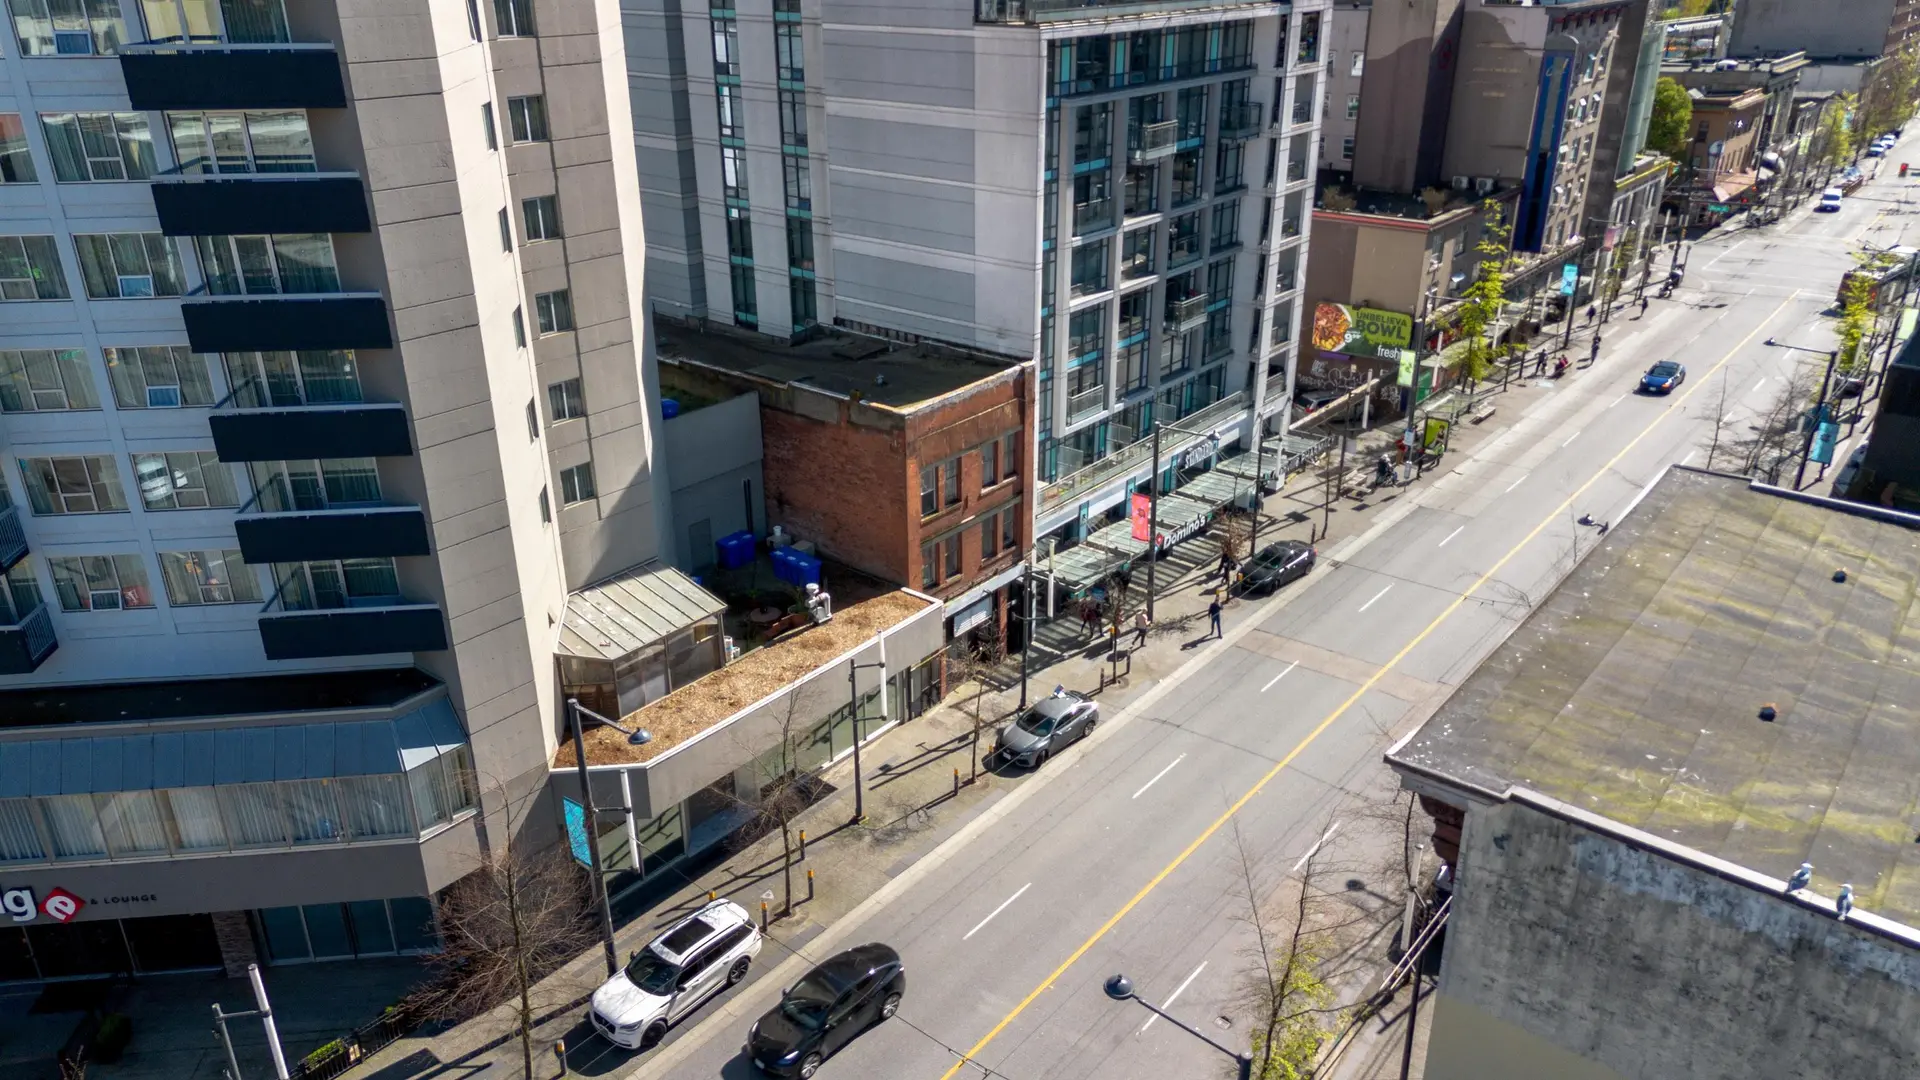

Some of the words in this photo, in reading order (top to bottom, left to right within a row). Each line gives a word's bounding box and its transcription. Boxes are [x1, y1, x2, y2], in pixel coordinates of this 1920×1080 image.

[1356, 312, 1407, 327] UNBELIEVA
[1356, 319, 1406, 341] BOWL
[1163, 514, 1206, 550] Domino's
[0, 889, 76, 922] ge
[104, 894, 157, 905] LOUNGE
